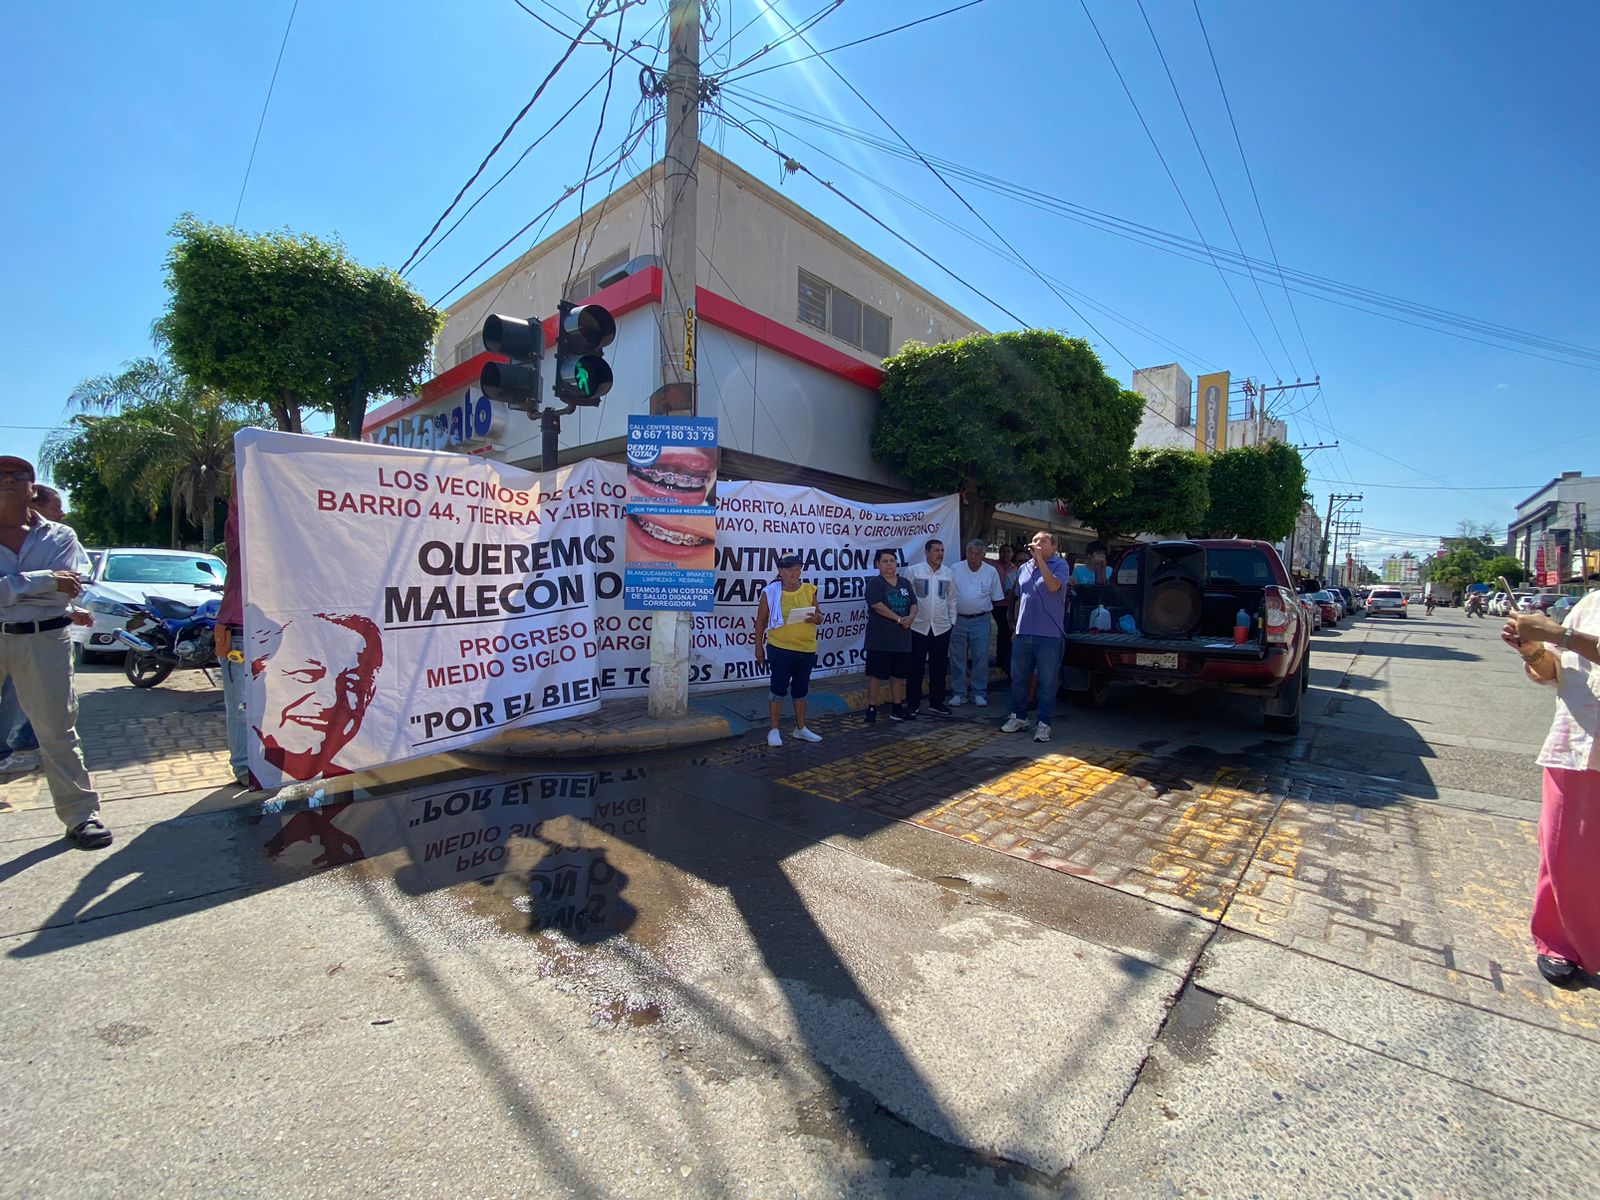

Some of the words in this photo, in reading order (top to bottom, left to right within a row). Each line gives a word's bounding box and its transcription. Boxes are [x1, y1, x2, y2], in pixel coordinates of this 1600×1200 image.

[627, 444, 658, 452] DENTAL
[630, 450, 654, 458] TOTAL
[643, 430, 662, 439] 667
[665, 430, 684, 440] 180
[686, 431, 699, 441] 33
[702, 431, 715, 441] 79
[317, 489, 422, 518] BARRIO
[429, 501, 460, 525] 44,
[466, 504, 542, 526] TIERRA
[545, 507, 559, 523] Y
[715, 516, 758, 535] MAYO,
[762, 519, 816, 534] RENATO
[818, 522, 850, 536] VEGA
[853, 524, 862, 536] Y
[378, 467, 429, 492] LOS
[435, 475, 529, 506] VECINOS
[790, 503, 855, 521] ALAMEDA,
[418, 534, 616, 576] QUEREMOS
[384, 572, 585, 624] MALECÓN
[625, 586, 660, 594] ESTAMOS
[679, 587, 715, 595] COSTADO
[426, 659, 505, 689] MEDIO
[511, 645, 577, 673] SIGLO
[725, 632, 756, 646] NOS
[459, 621, 587, 658] PROGRESO
[410, 701, 496, 739] "POR
[503, 693, 535, 721] EL
